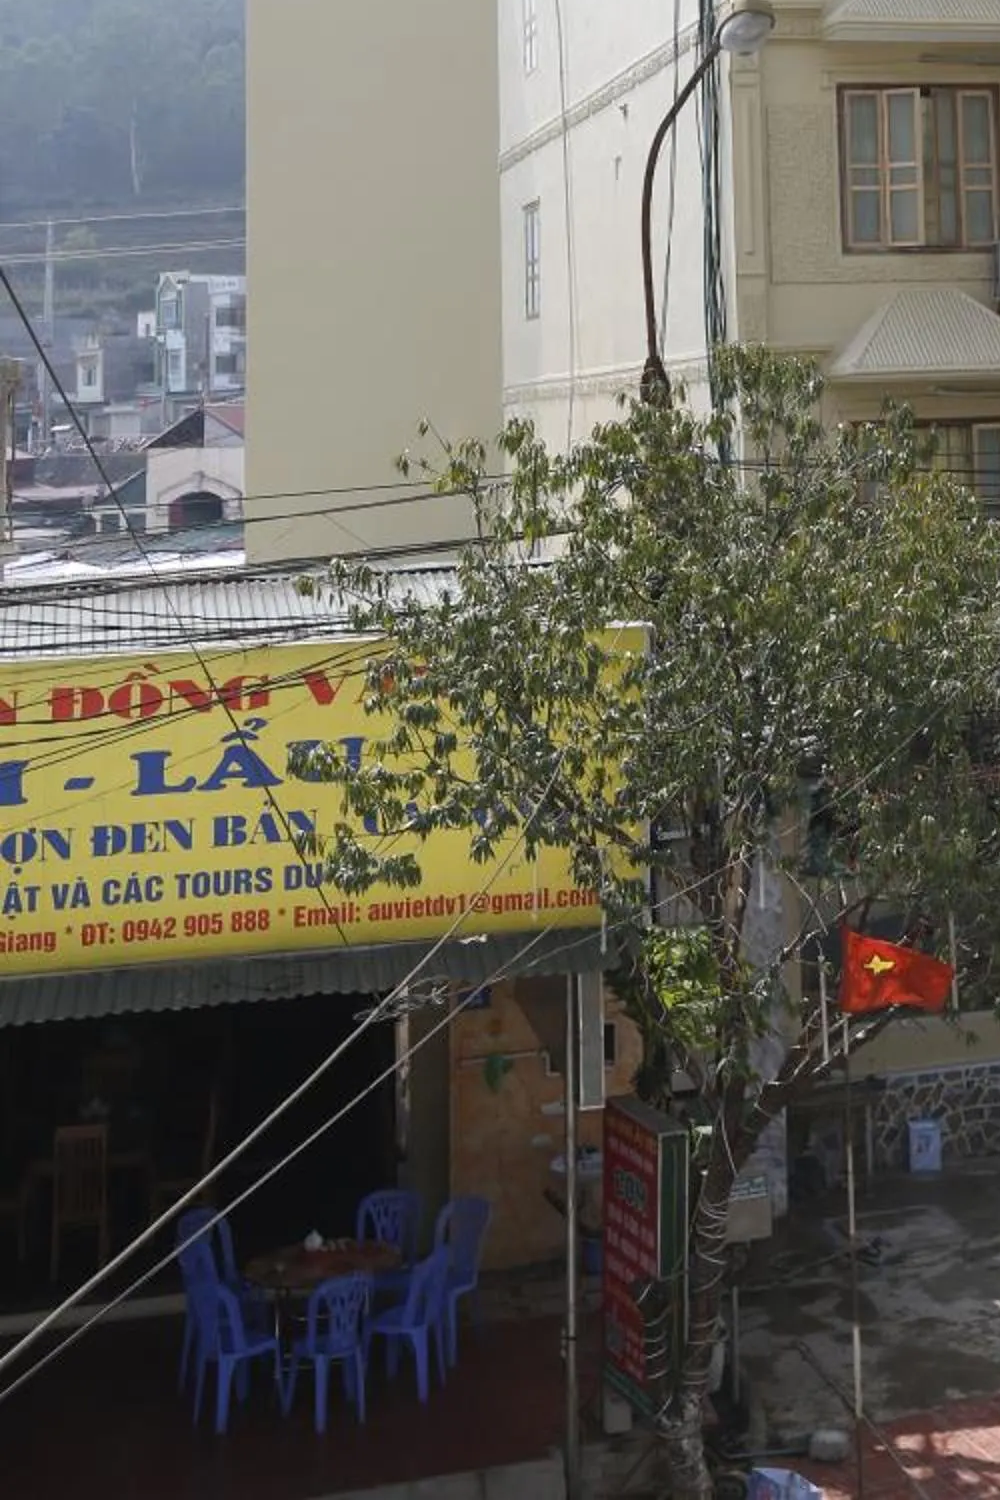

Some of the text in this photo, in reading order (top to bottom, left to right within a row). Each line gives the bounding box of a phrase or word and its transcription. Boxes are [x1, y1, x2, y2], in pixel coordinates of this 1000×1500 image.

[48, 663, 270, 721] ĐỒNG
[90, 818, 195, 857] ĐEN
[51, 876, 91, 910] VÀ
[102, 872, 165, 906] CÁC
[175, 866, 273, 900] TOURS
[81, 922, 115, 947] ĐT:
[122, 918, 177, 944] 0942
[184, 914, 223, 937] 905
[231, 909, 270, 932] 888
[293, 902, 361, 928] Email:
